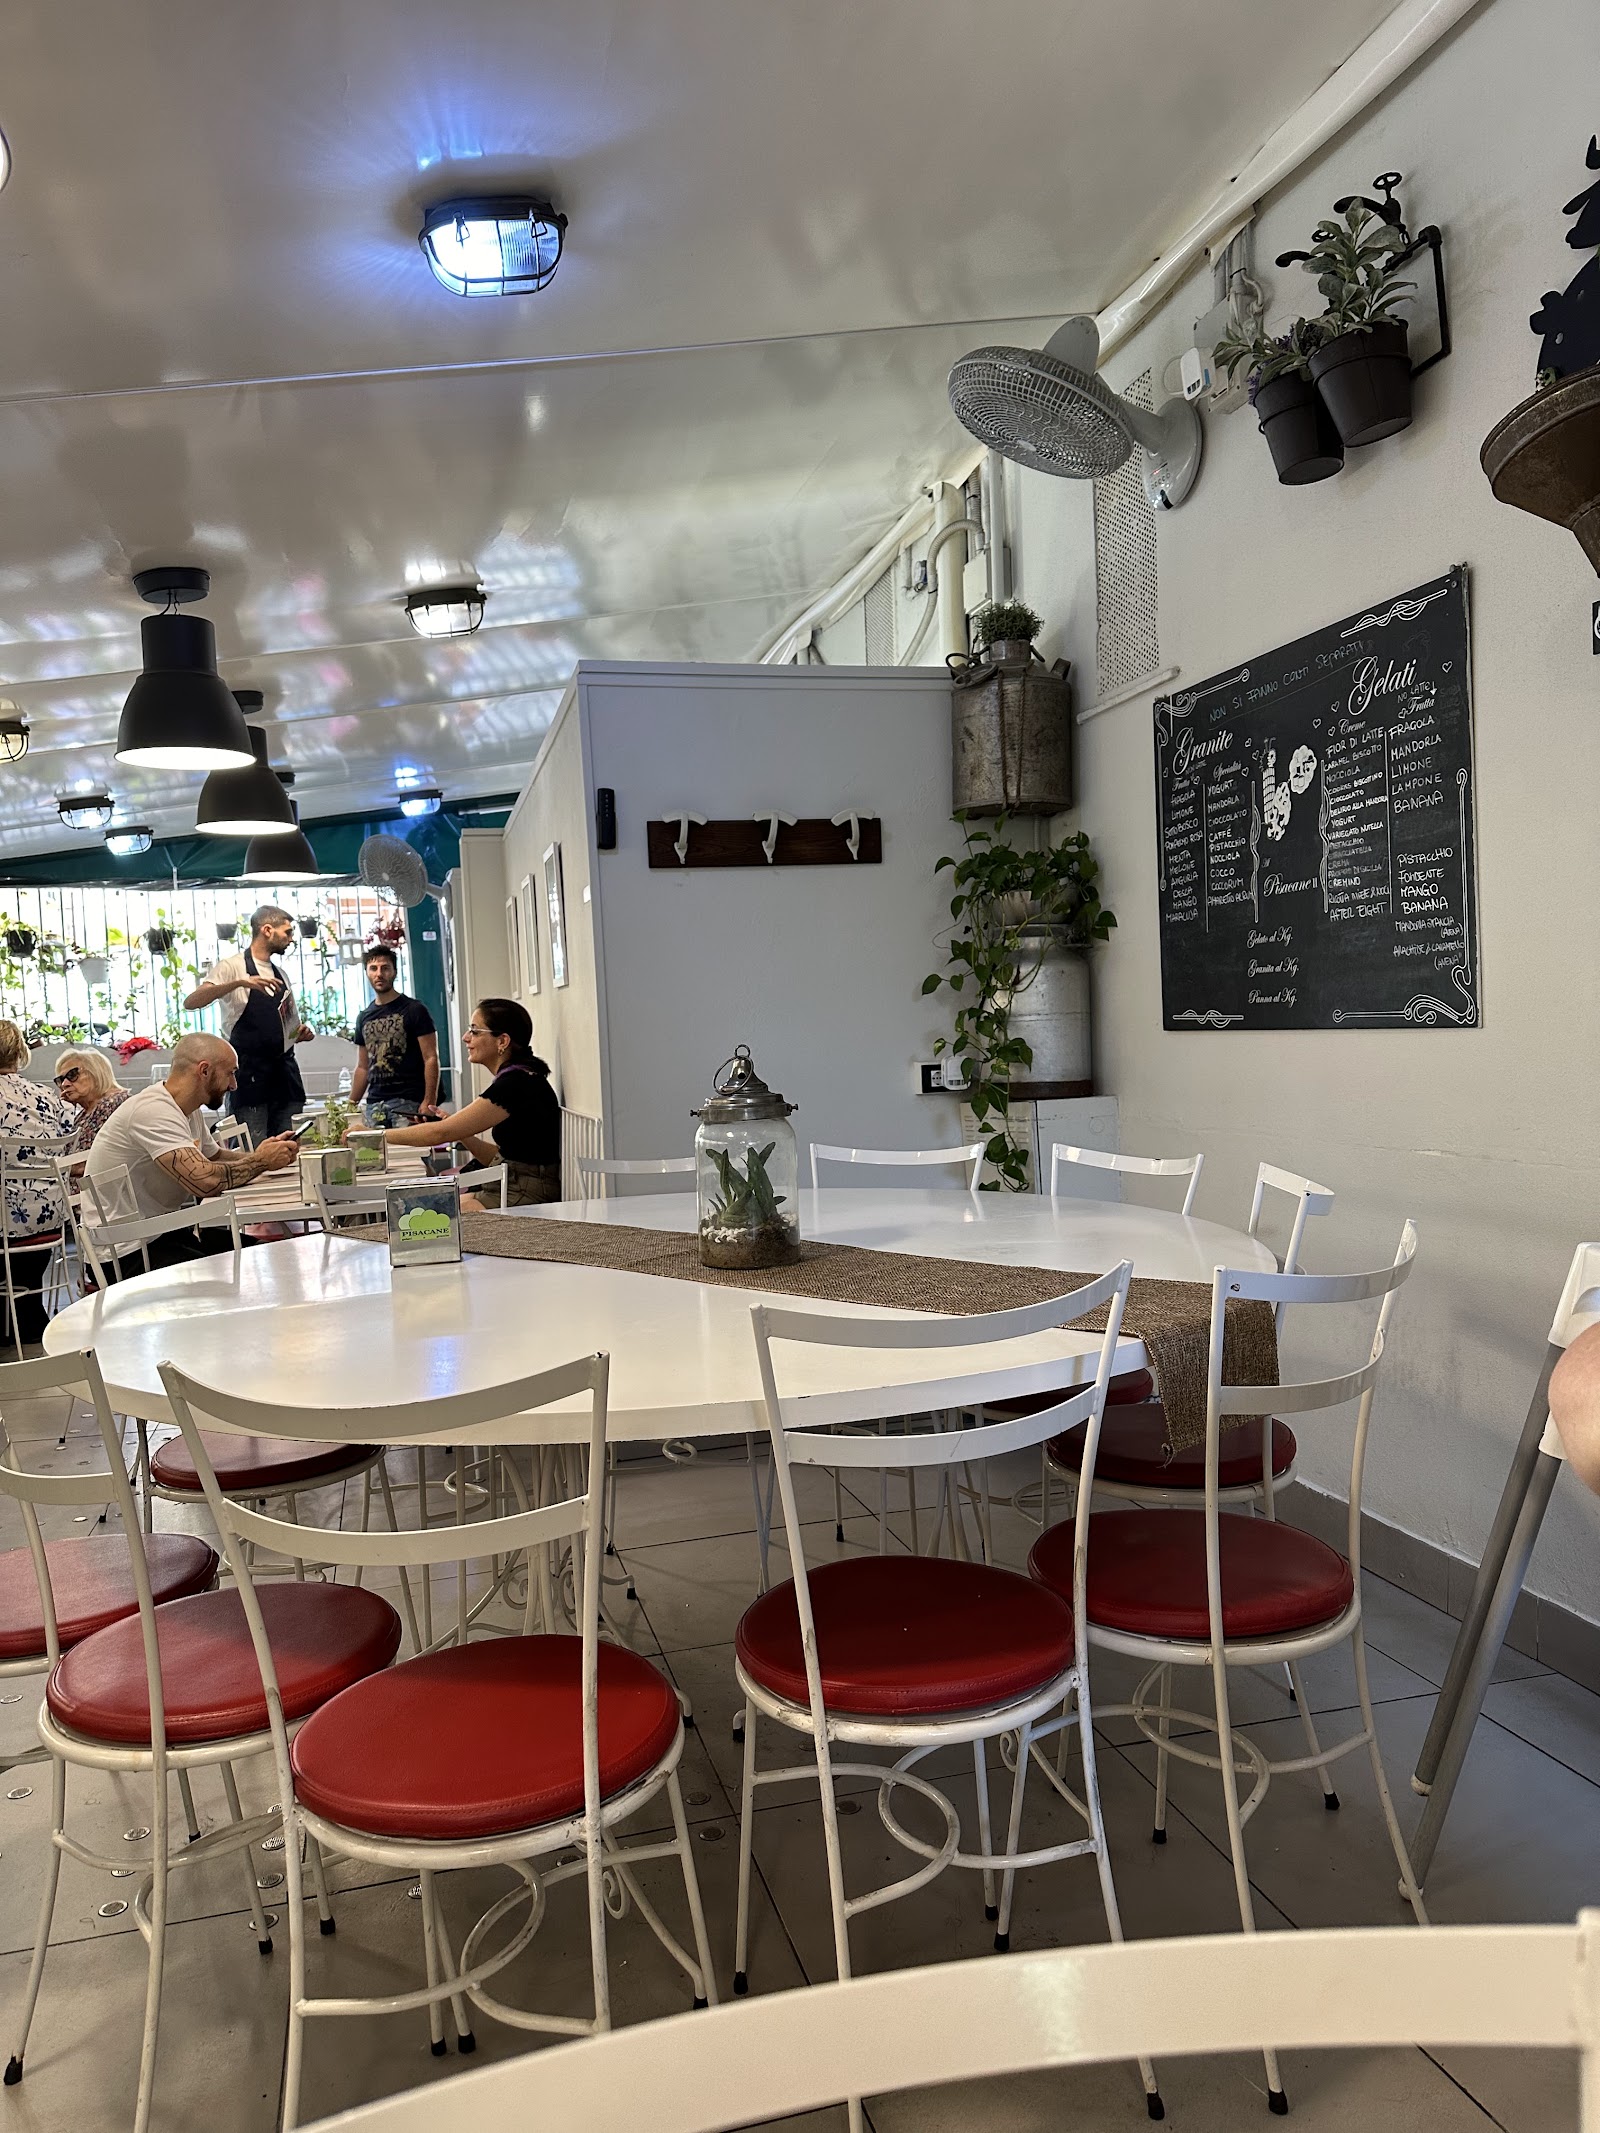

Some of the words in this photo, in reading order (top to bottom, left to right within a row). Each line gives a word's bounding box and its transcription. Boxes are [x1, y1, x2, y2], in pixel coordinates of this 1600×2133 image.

[1348, 656, 1417, 716] Gelati
[1398, 692, 1407, 703] NO
[1411, 681, 1430, 694] LATTE
[1209, 705, 1226, 723] NON
[1246, 680, 1278, 702] FANNO
[1407, 695, 1435, 715] Frutta
[1338, 719, 1366, 735] Creme
[1388, 715, 1435, 740] FRAGOLA
[1173, 727, 1233, 775] Granite
[1326, 740, 1346, 758] FIOR
[1349, 738, 1357, 748] DI
[1362, 726, 1384, 743] LATTE
[1391, 734, 1442, 761] MANDORLA
[1352, 744, 1382, 760] BISCOTTO
[1326, 766, 1360, 785] NOCCIOLA
[1392, 757, 1432, 778] LIMONE
[1208, 779, 1234, 796] YOGURT
[1392, 773, 1442, 795] LAMPONE
[1208, 795, 1239, 813] MANDORLA
[1330, 790, 1364, 804] CIOCCOLATO
[1352, 801, 1364, 810] ALLA
[1394, 790, 1444, 814] BANANA
[1172, 806, 1194, 820] LIMONE
[1208, 809, 1247, 827] CIOCCOLATO
[1331, 815, 1356, 828] YOGURT
[1328, 828, 1359, 840] VARIEGATO
[1360, 821, 1384, 833] NUTELLA
[1209, 837, 1246, 853] PISTACCHIO
[1169, 850, 1191, 864] MENTA
[1210, 851, 1240, 864] NOCCIOLA
[1397, 847, 1453, 867] PISTACCHIO
[1170, 860, 1195, 875] MELONE
[1210, 868, 1235, 878] COCCO
[1398, 868, 1444, 884] FONDENTE
[1171, 871, 1198, 889] ANGURIA
[1263, 873, 1312, 897] Pisacane
[1328, 876, 1360, 888] CREMINO
[1400, 883, 1438, 897] MANGO
[1173, 896, 1197, 909] MANGO
[1330, 907, 1354, 922] AFTER
[1356, 901, 1388, 918] EIGHT
[1401, 896, 1449, 914] BANANA
[1247, 929, 1268, 948] Gelato
[1269, 931, 1277, 943] al
[1248, 958, 1274, 978] Granita
[1275, 961, 1283, 972] al
[1248, 990, 1272, 1004] Panna
[1273, 992, 1282, 1003] al
[364, 1018, 401, 1036] ESCAPE
[402, 1228, 449, 1237] PISACANE
